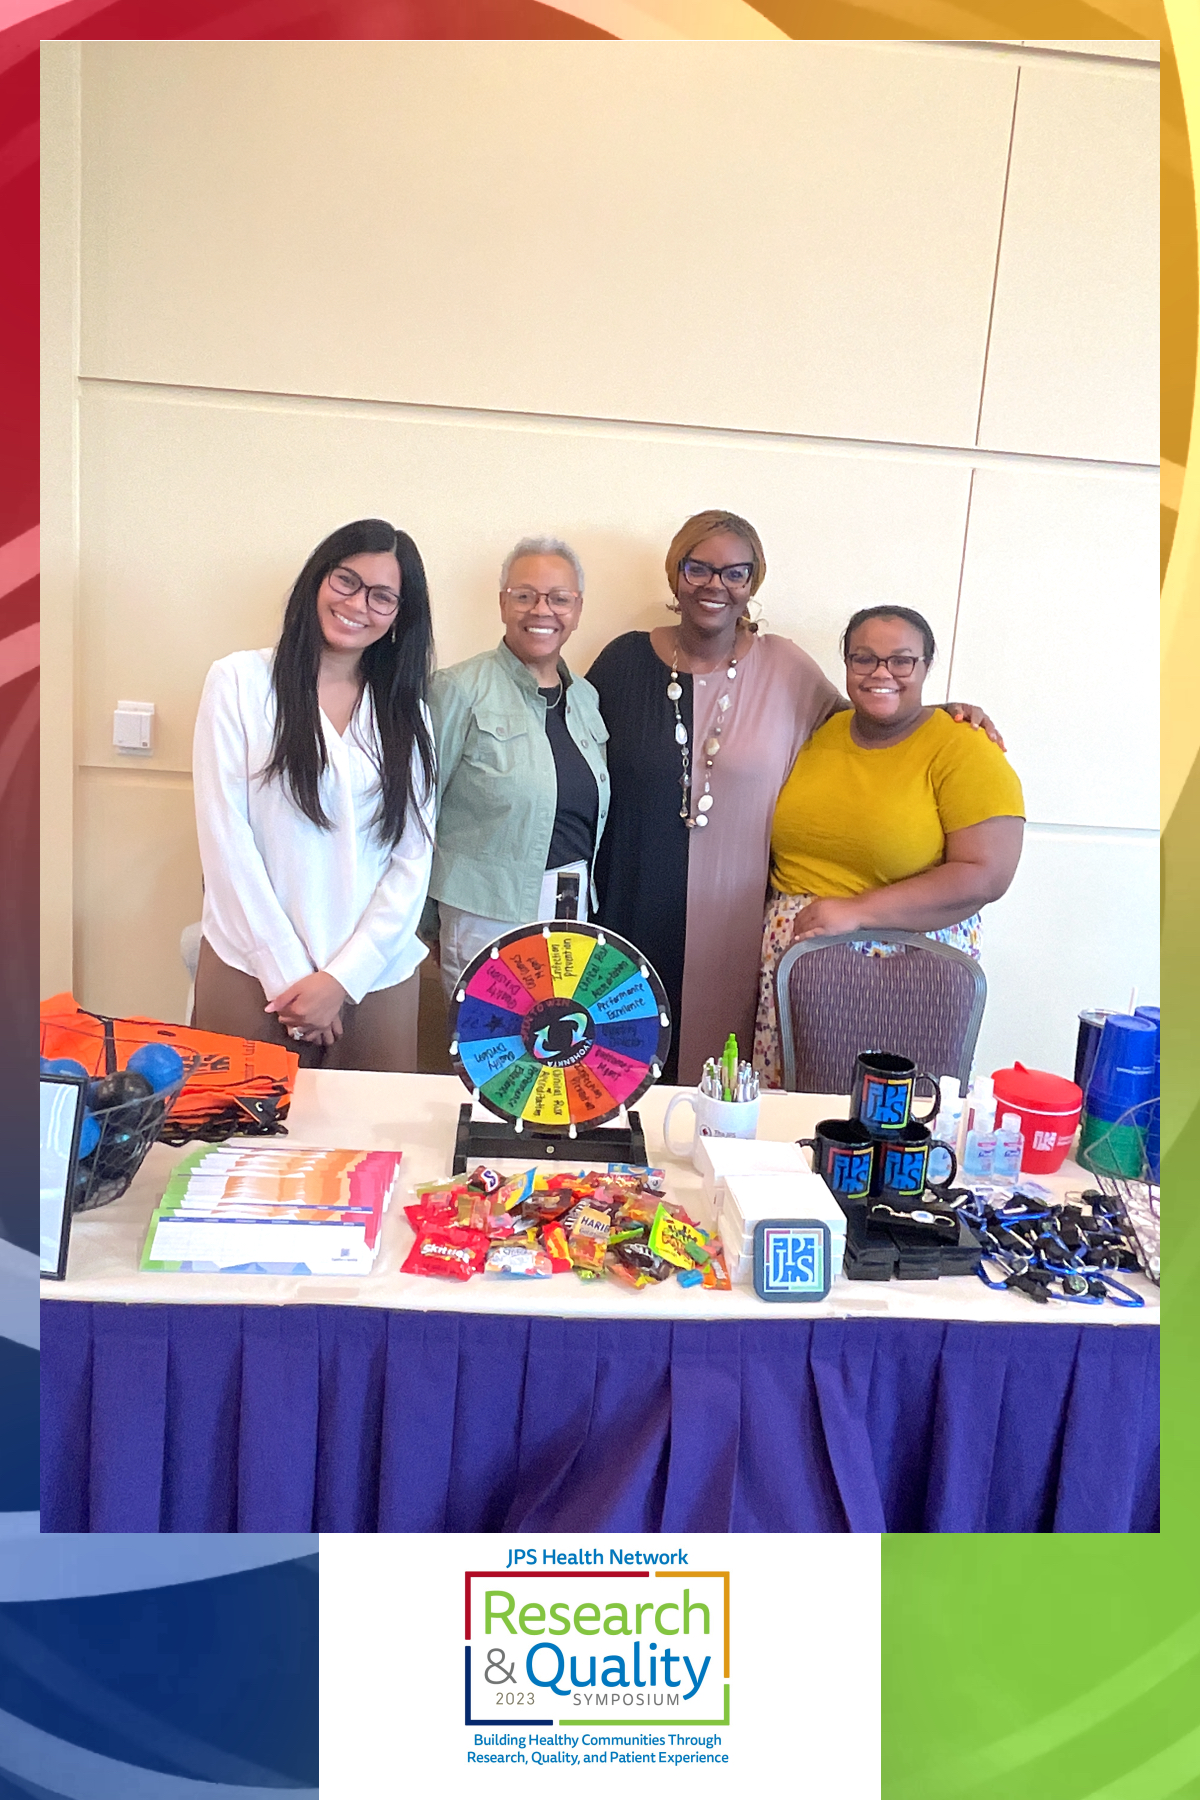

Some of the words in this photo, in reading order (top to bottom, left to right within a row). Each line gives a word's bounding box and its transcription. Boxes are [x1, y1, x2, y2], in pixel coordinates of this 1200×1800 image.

[487, 965, 521, 996] Division
[551, 944, 562, 981] Infection
[487, 981, 517, 1010] Quality
[596, 983, 645, 1012] Performance
[487, 1050, 516, 1072] Quality
[866, 1083, 906, 1122] JPS
[833, 1154, 869, 1192] JPS
[884, 1151, 923, 1190] JPS
[772, 1236, 816, 1284] JPS
